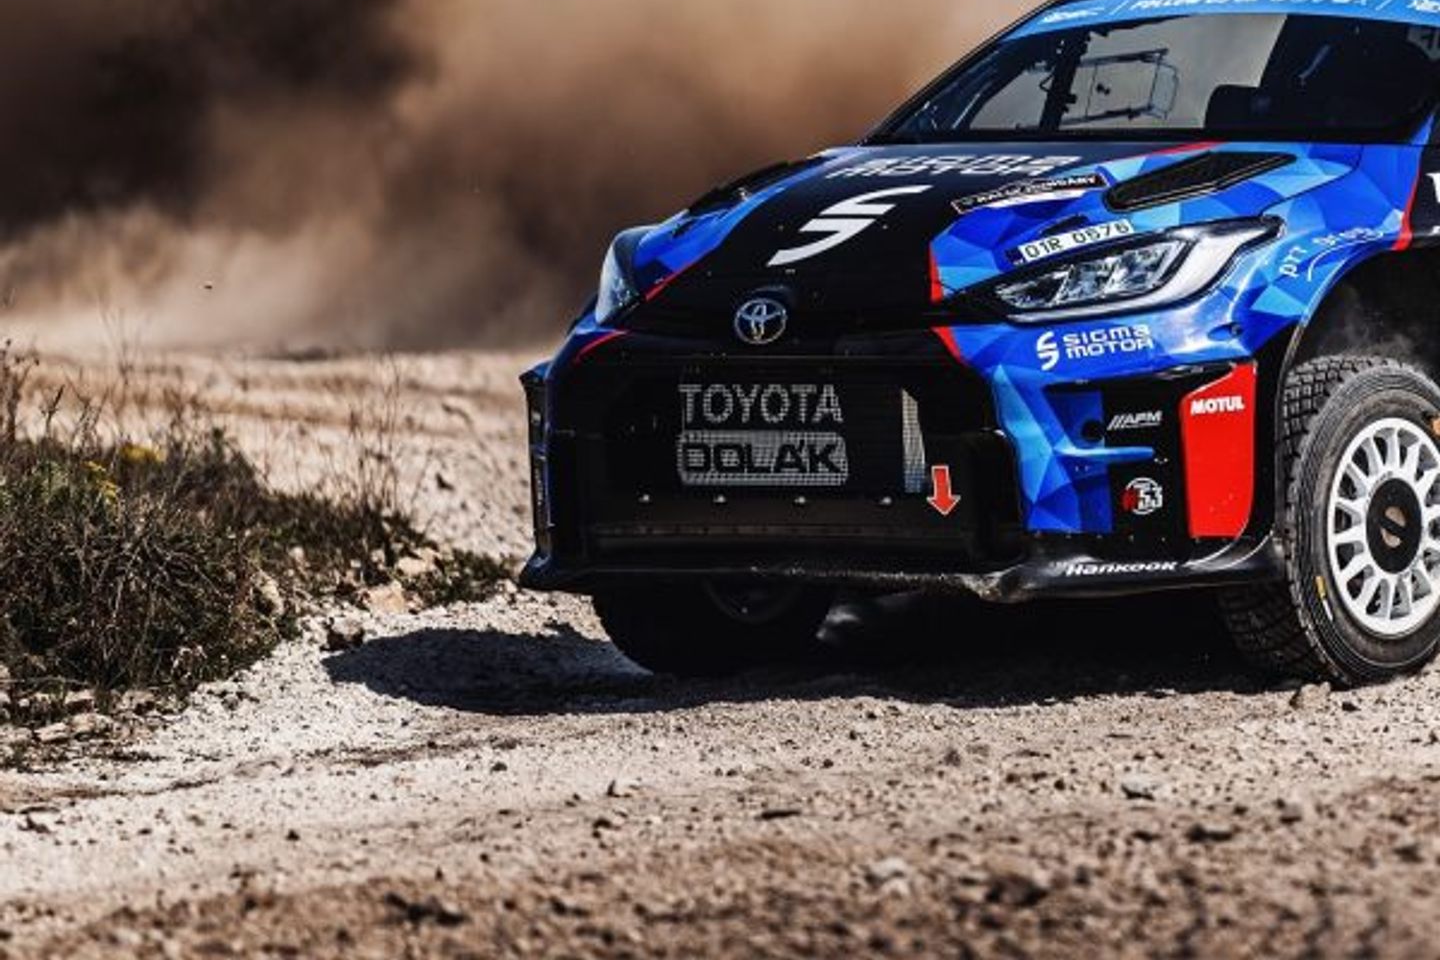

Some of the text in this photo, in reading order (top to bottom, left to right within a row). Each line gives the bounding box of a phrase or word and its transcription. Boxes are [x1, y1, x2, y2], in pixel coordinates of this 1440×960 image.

[677, 383, 844, 424] TOYOTA
[1190, 395, 1245, 416] MOTUL
[681, 441, 842, 475] DOLAK
